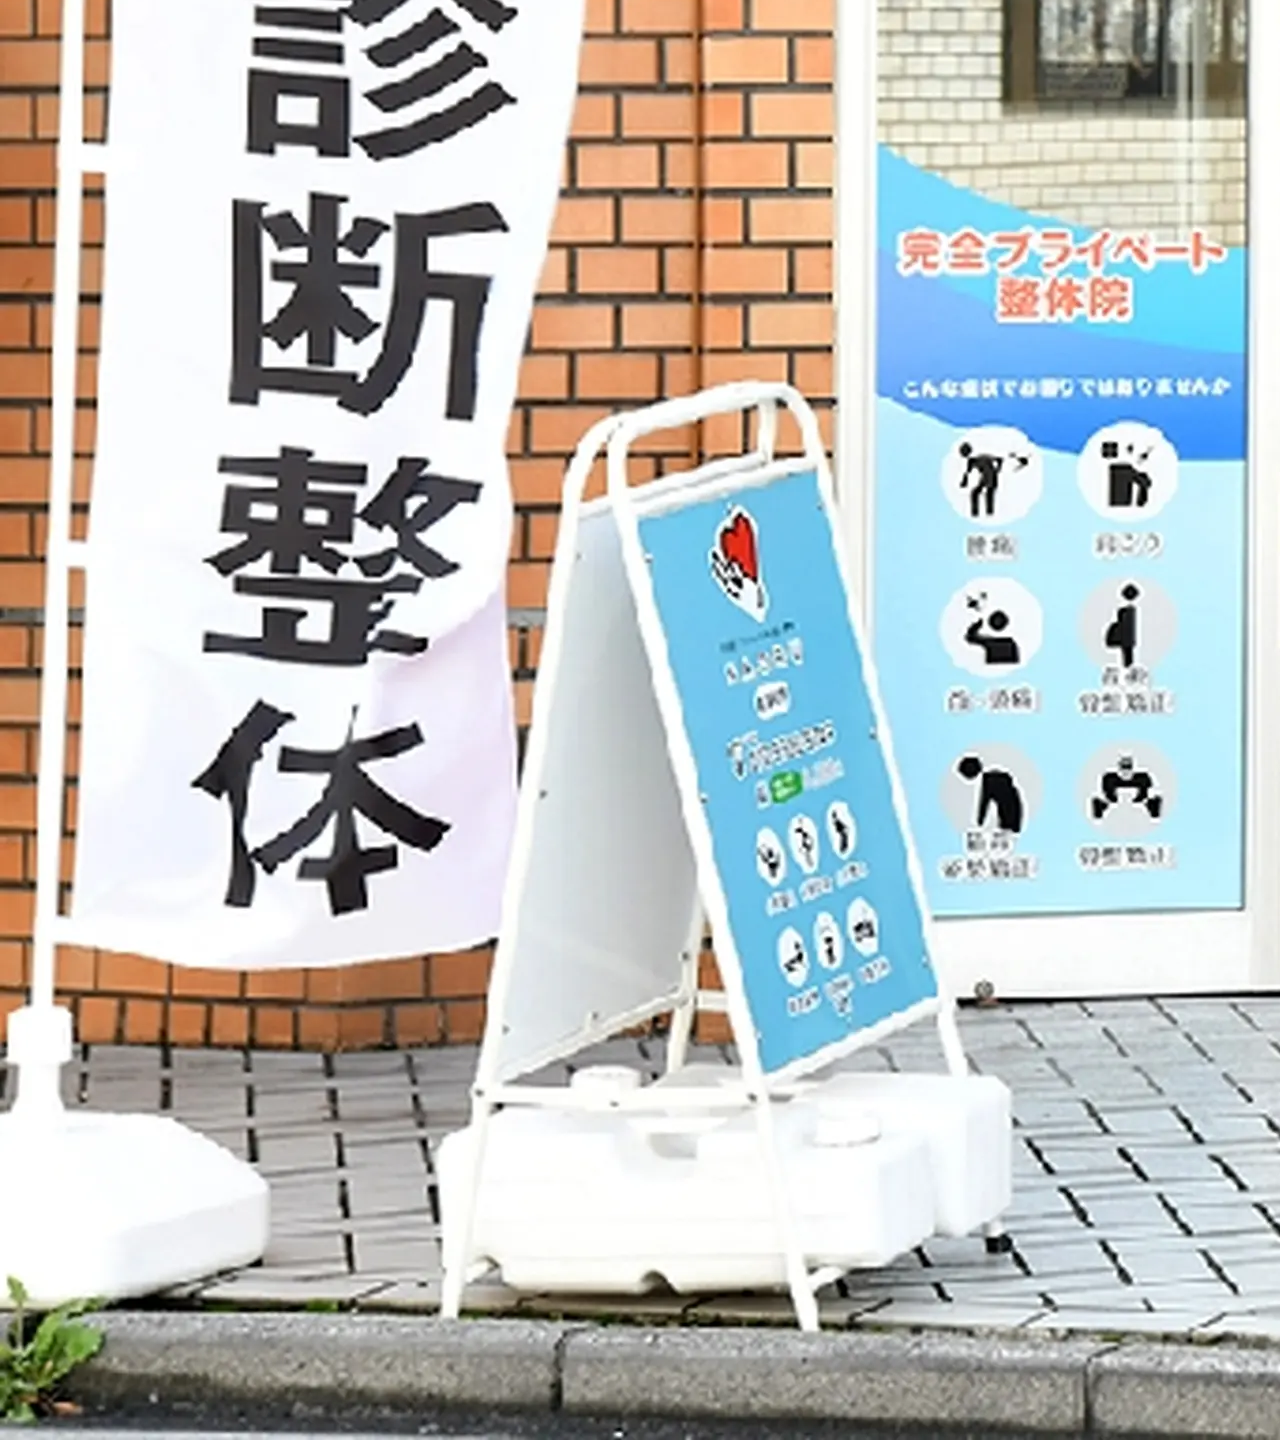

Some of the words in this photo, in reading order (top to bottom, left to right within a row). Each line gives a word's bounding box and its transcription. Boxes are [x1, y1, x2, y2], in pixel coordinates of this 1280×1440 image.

[902, 232, 1224, 270] 完全プライベート
[999, 278, 1130, 318] 整体院
